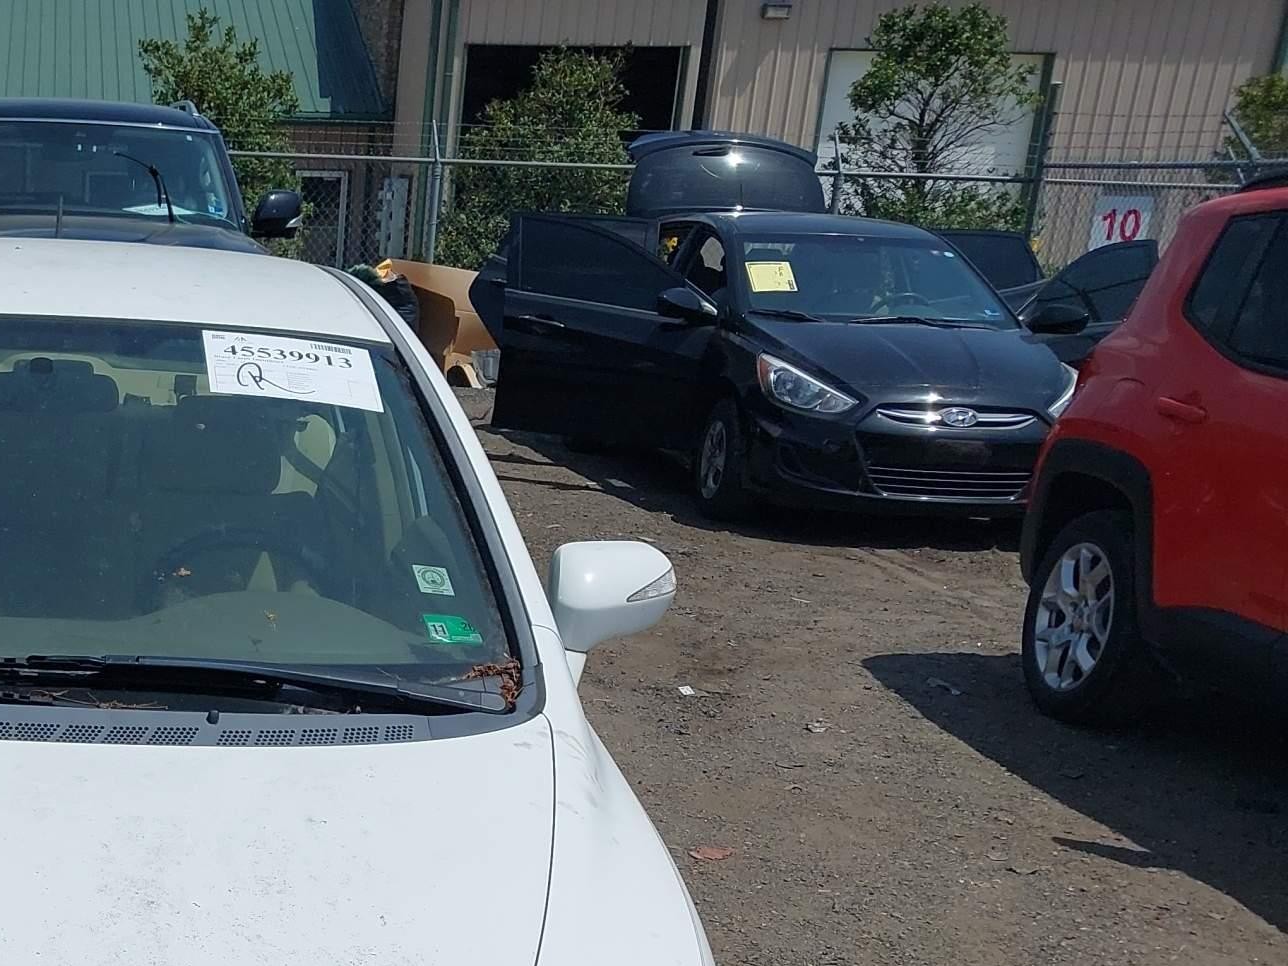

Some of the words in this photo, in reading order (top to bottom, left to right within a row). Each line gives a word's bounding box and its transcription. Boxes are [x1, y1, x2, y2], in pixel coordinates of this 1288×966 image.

[1103, 208, 1142, 241] 10
[223, 345, 353, 369] 45539913
[430, 624, 447, 635] 11
